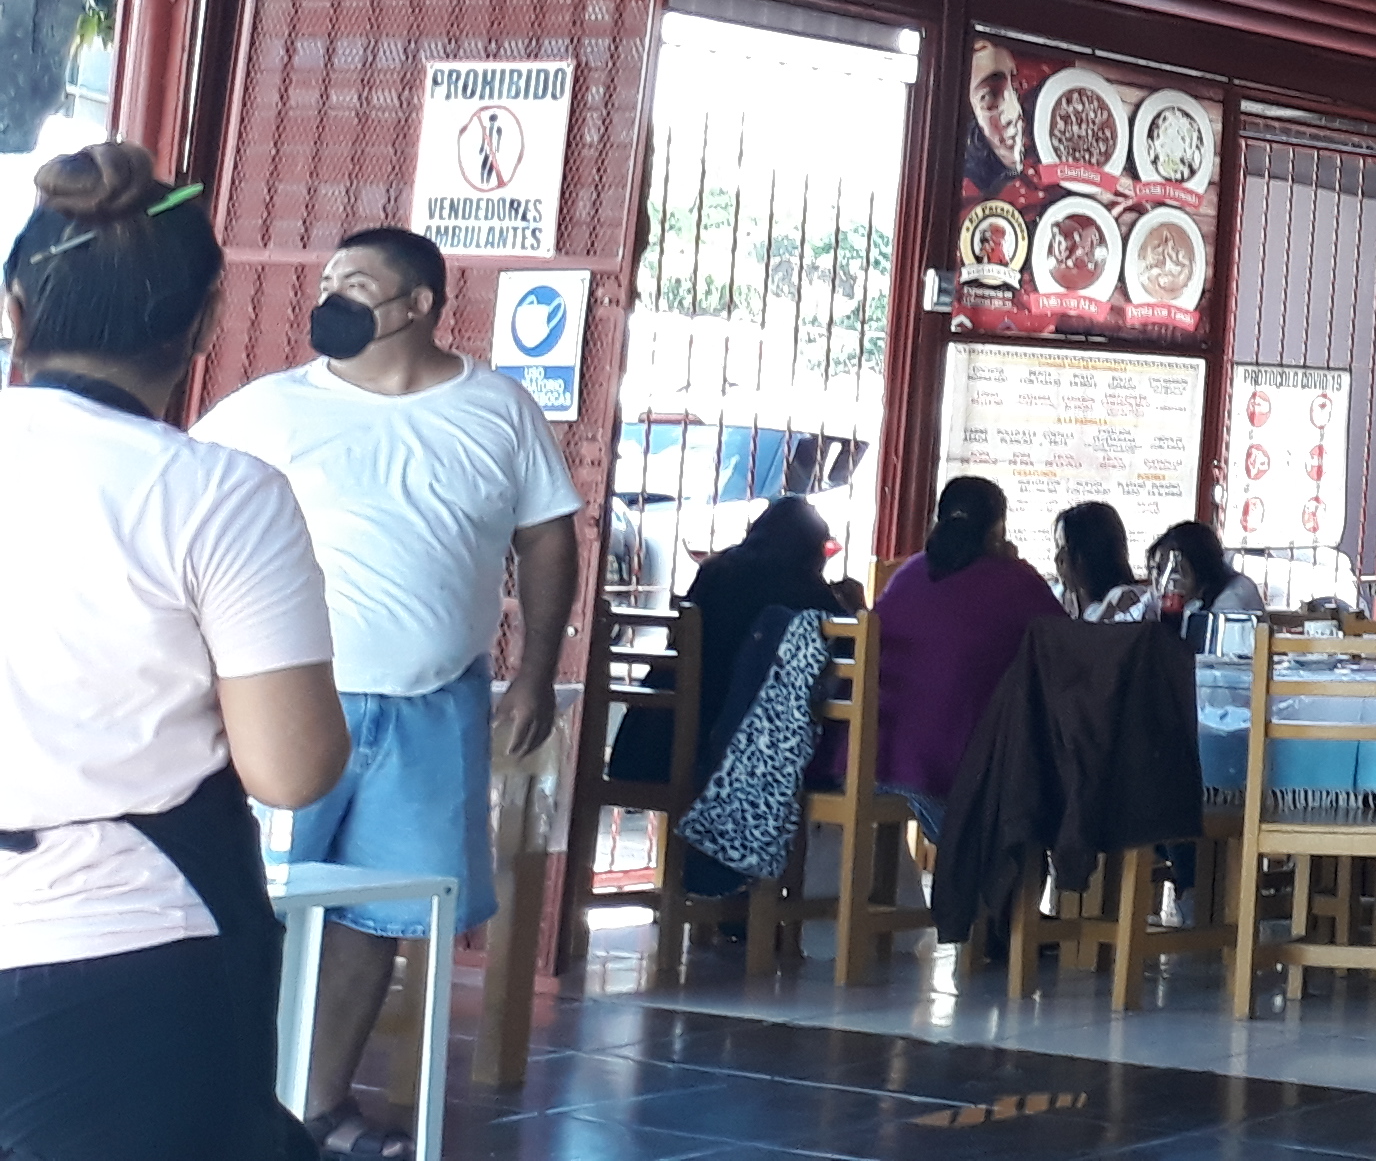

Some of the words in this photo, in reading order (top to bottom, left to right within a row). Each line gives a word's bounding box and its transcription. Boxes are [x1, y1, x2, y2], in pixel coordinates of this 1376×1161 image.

[430, 68, 567, 101] PROHIBIDO
[428, 196, 542, 223] VENDEDORES
[423, 224, 542, 251] AMBULANTES
[1244, 368, 1298, 388] PROTOCOLO
[1300, 371, 1328, 390] COVID
[1331, 373, 1342, 392] 19
